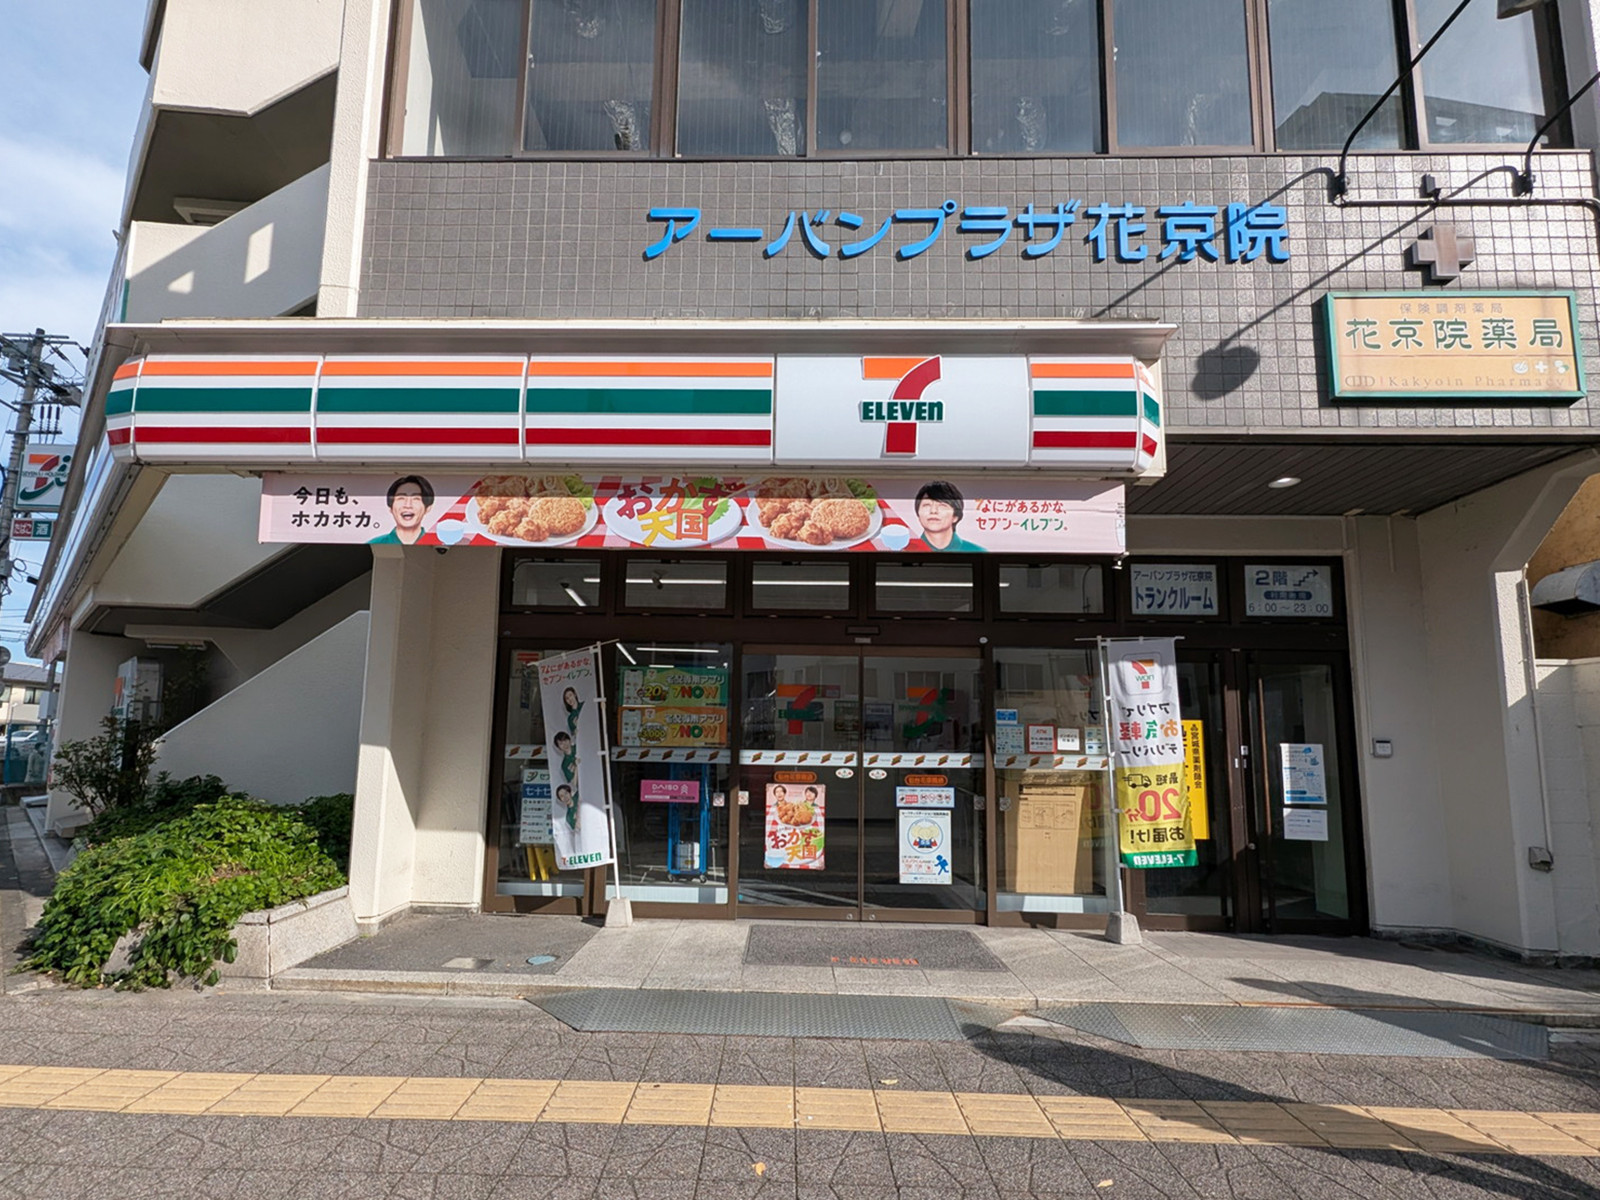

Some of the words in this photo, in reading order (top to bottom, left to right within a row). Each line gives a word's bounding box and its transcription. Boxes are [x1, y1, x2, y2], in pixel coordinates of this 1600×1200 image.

[646, 198, 1290, 261] アーバンプラザ花京院
[1345, 318, 1563, 350] 花京院薬局
[1388, 376, 1463, 389] Kakyoin
[862, 401, 943, 420] ELEVEN
[292, 486, 360, 506] 今日も、
[616, 477, 745, 519] おかず
[291, 510, 381, 529] ホカホカ。
[638, 508, 708, 547] 天国
[36, 523, 49, 535] 酒
[1133, 570, 1213, 582] アーバンプラザ花京院
[1255, 570, 1288, 586] 2階
[1134, 586, 1214, 610] トランクルーム
[673, 685, 719, 699] 7NOW
[670, 725, 718, 738] 7NOW
[561, 852, 602, 866] 7-ELEVEN
[785, 845, 817, 862] 天国
